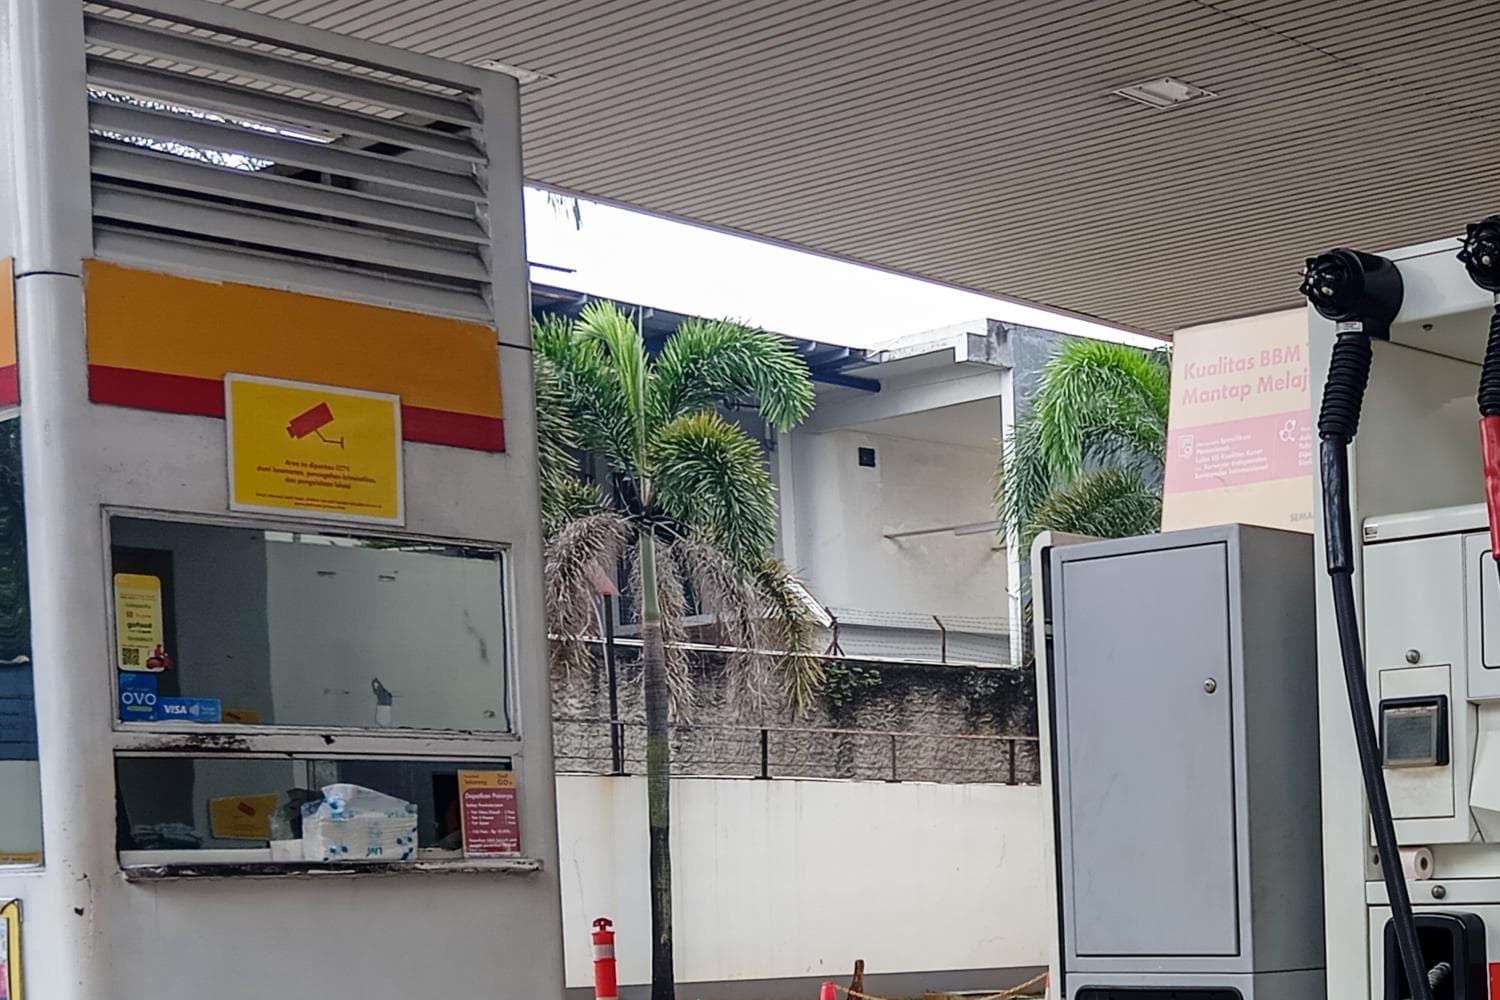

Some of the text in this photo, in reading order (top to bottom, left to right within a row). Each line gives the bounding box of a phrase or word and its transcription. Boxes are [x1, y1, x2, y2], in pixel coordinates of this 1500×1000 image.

[1184, 344, 1300, 380] Kualitas BBM
[1183, 367, 1308, 405] Mantap Melaj
[122, 692, 157, 705] OVO
[163, 704, 187, 714] VISA
